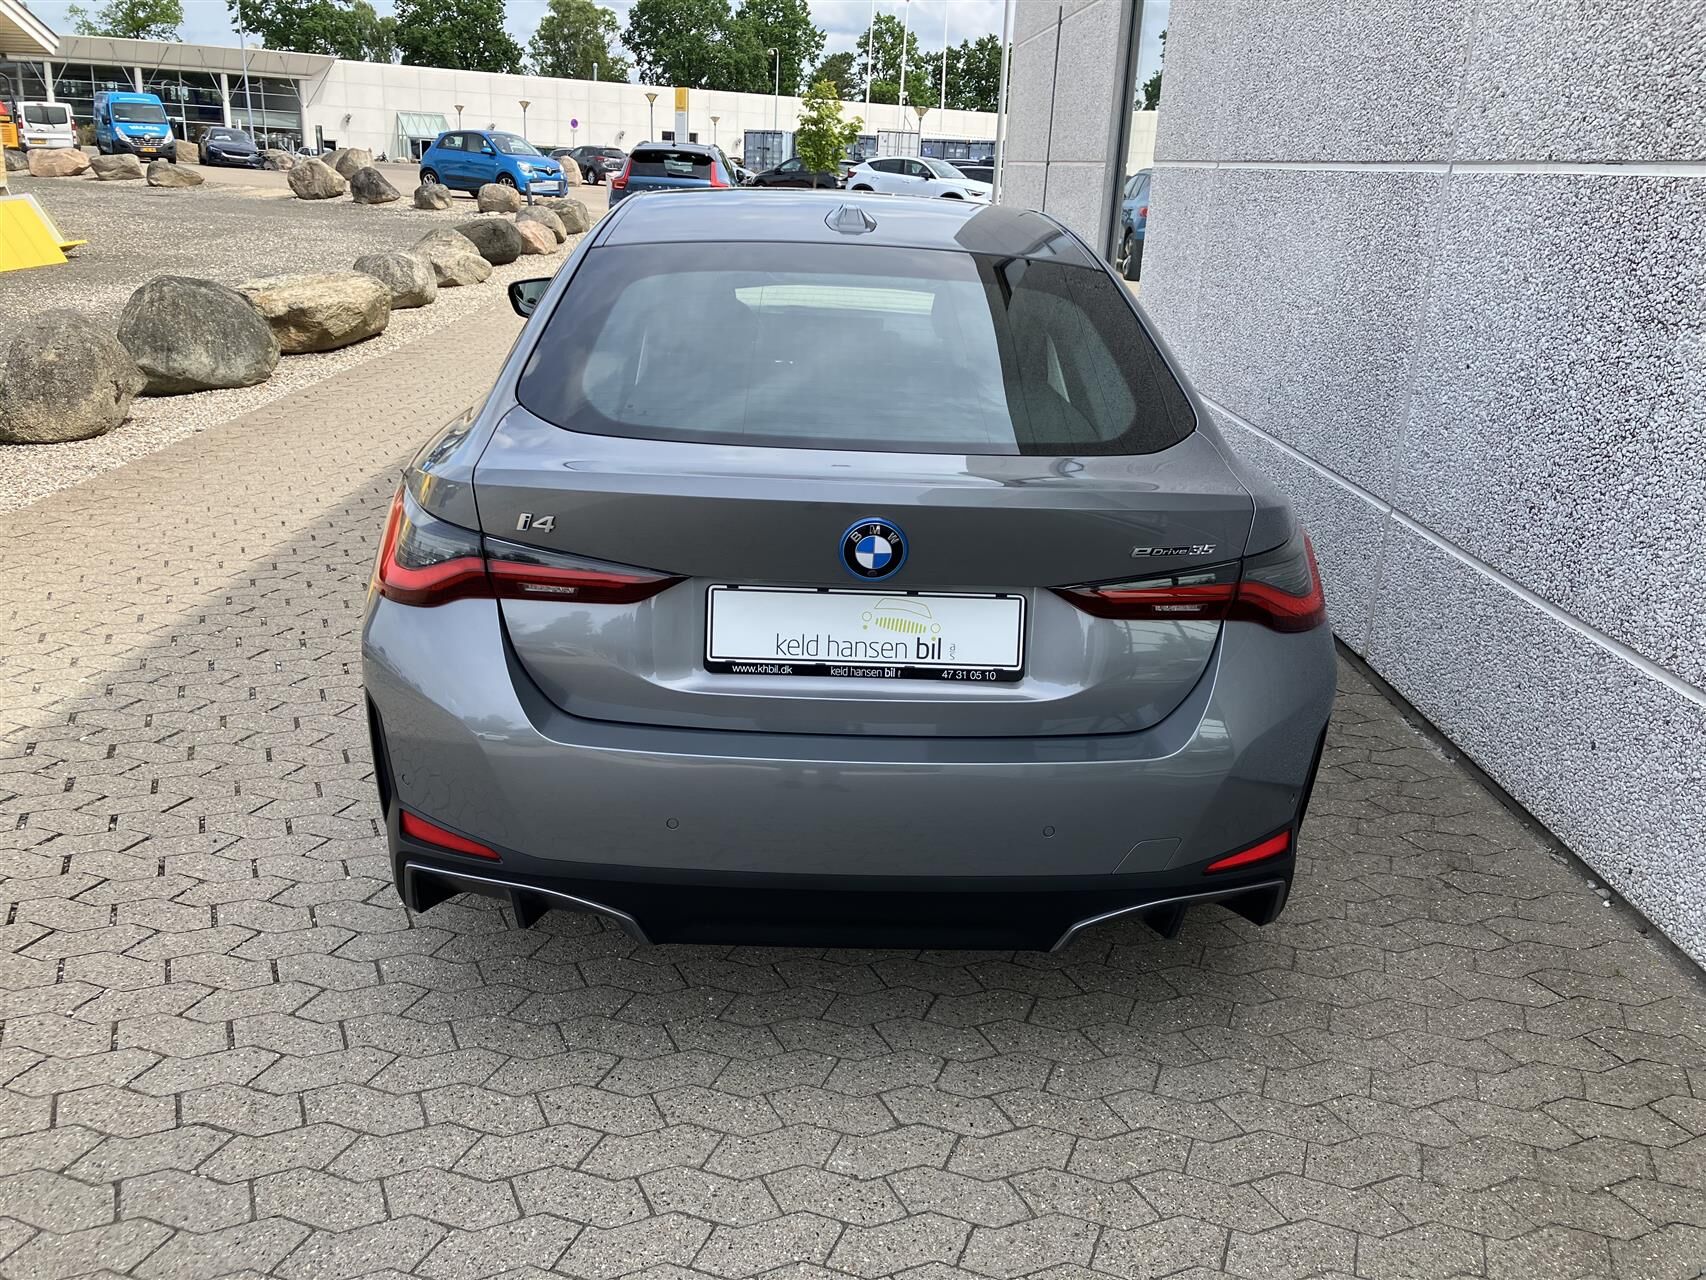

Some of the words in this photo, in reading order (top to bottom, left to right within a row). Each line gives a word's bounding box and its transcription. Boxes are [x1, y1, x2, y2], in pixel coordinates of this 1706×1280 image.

[516, 512, 556, 533] i4
[850, 525, 900, 545] BMW
[776, 633, 818, 656] keld
[828, 635, 908, 659] hansen
[916, 636, 942, 660] bil
[732, 664, 793, 675] www.khbil.dk
[830, 666, 848, 676] keld
[850, 667, 882, 677] hansen
[884, 667, 895, 677] bil
[941, 670, 954, 679] 47
[956, 671, 967, 679] 31
[970, 671, 982, 680] 05
[985, 672, 996, 680] 10
